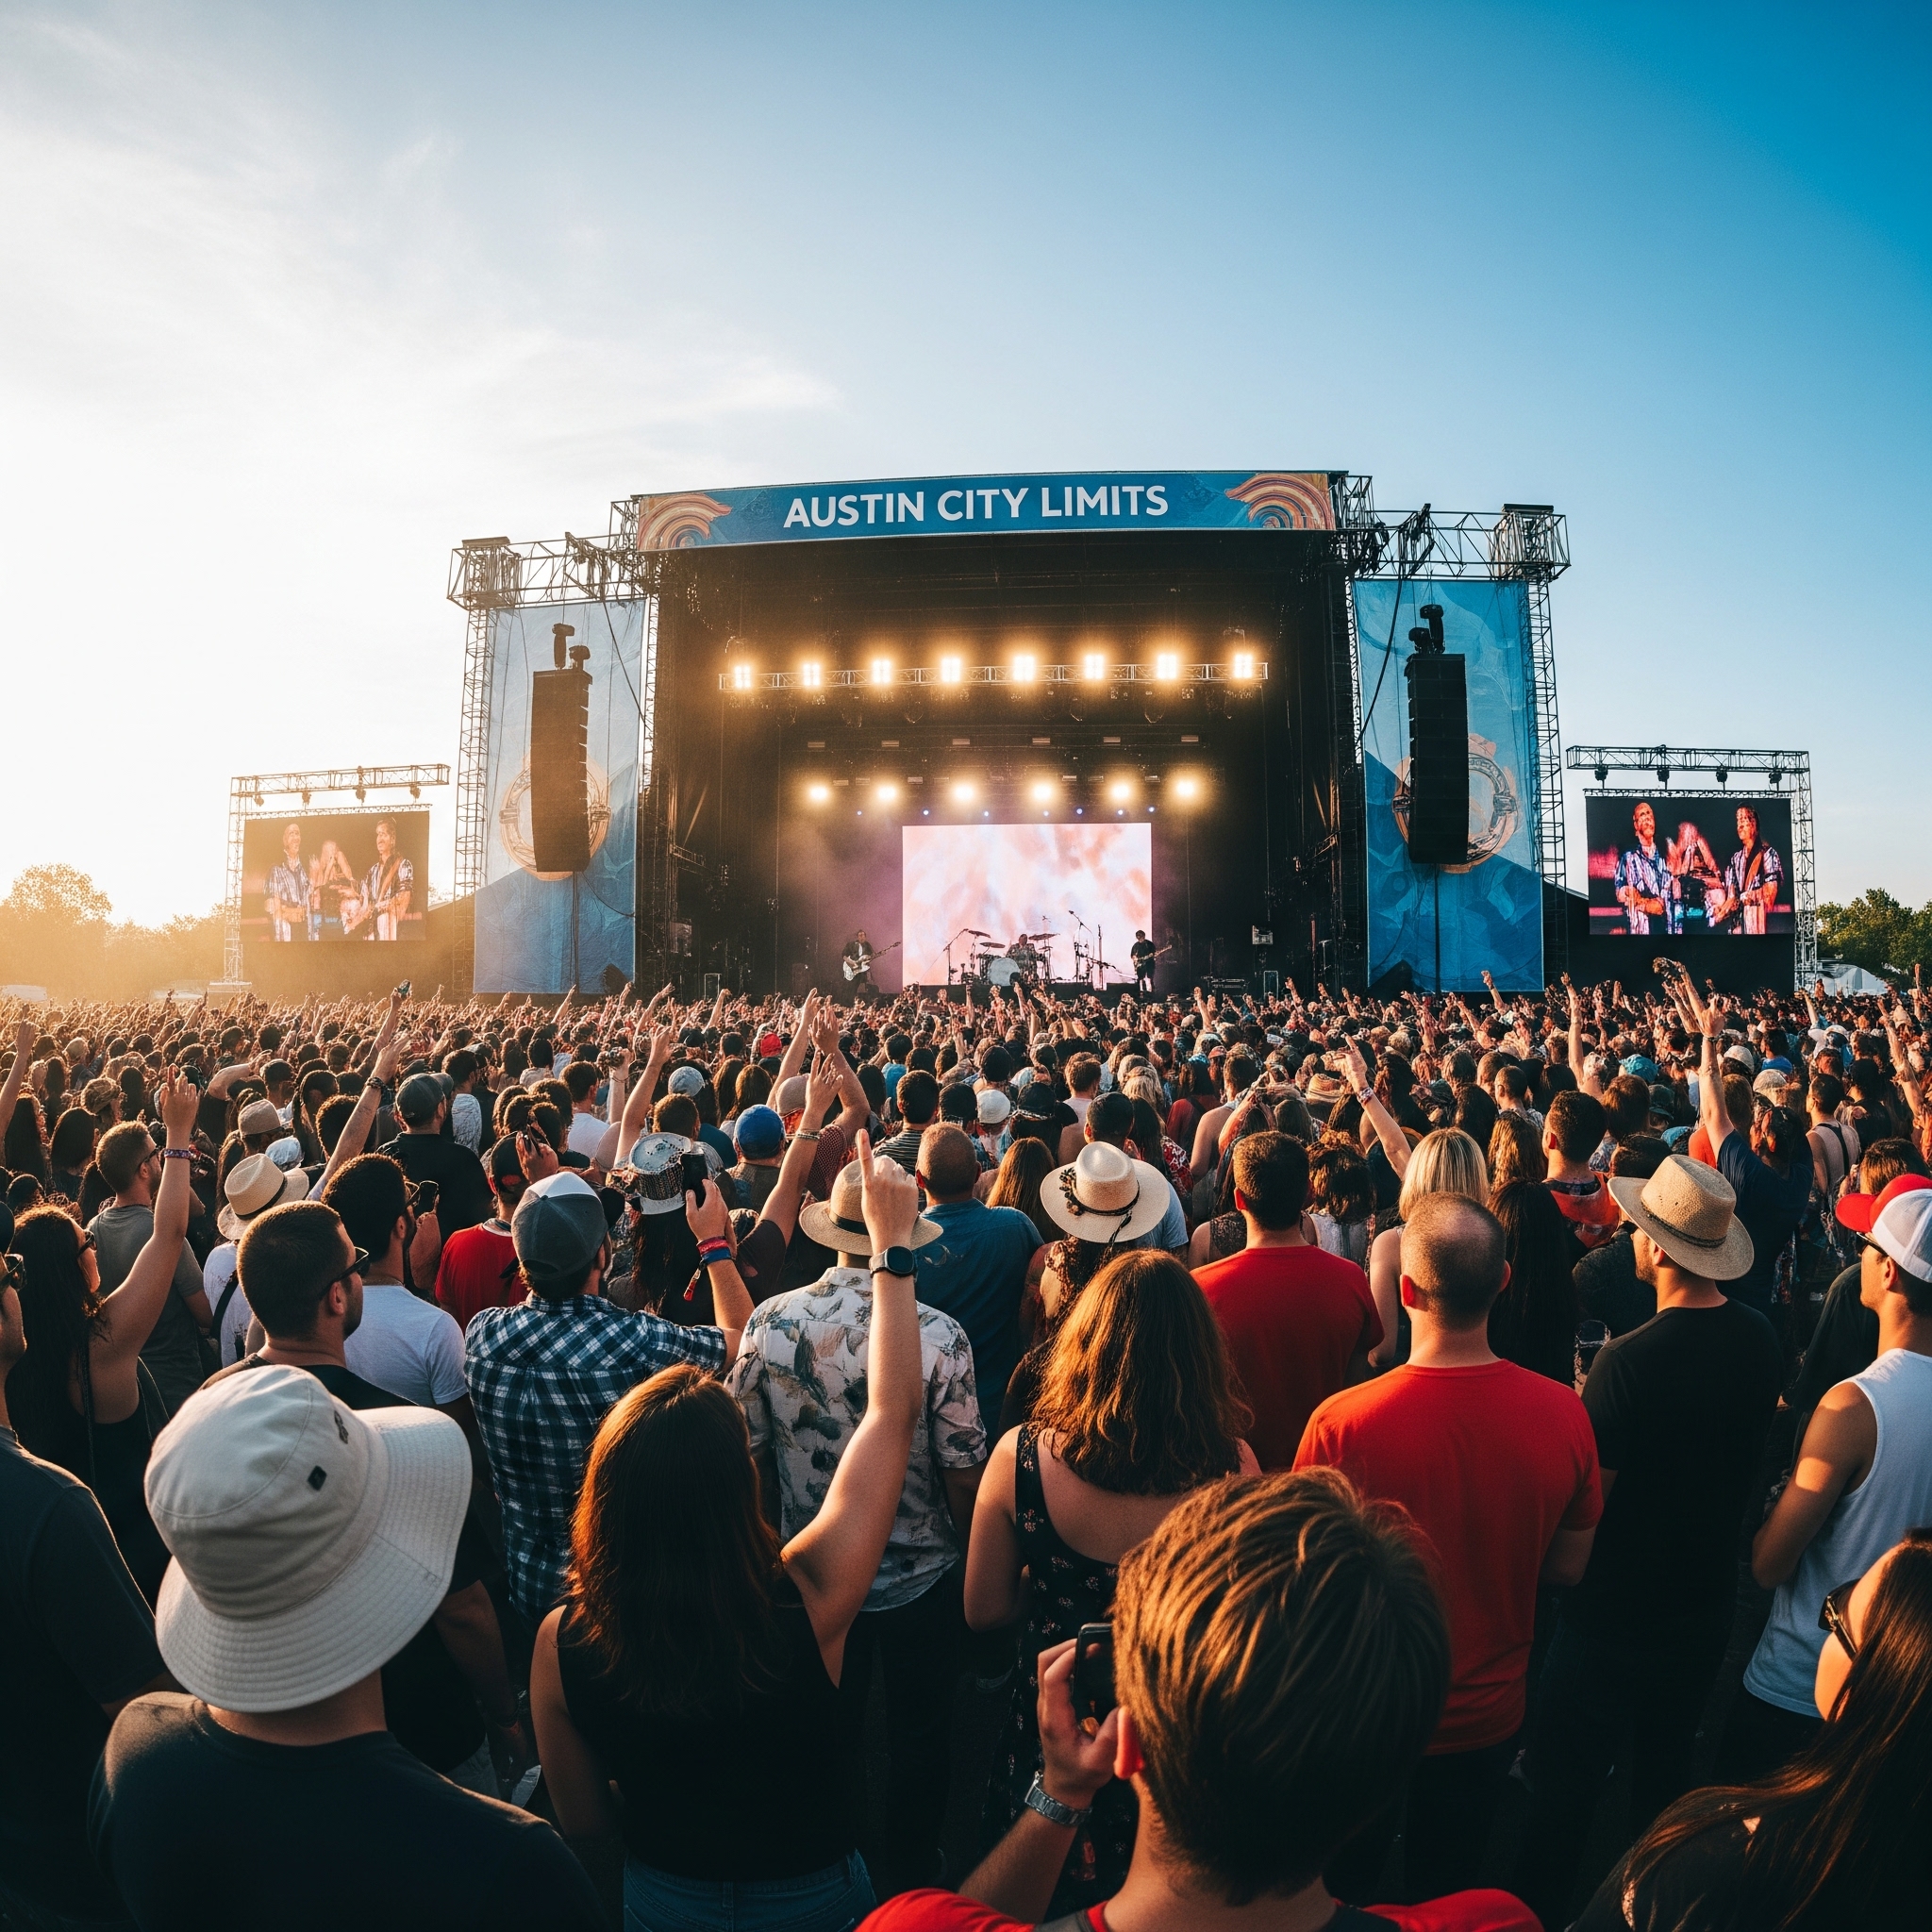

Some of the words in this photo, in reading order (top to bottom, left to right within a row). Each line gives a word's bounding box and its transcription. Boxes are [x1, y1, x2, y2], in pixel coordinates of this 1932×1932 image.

[783, 491, 924, 528] AUSTIN
[937, 488, 1029, 521] CITY
[1041, 485, 1169, 517] LIMITS
